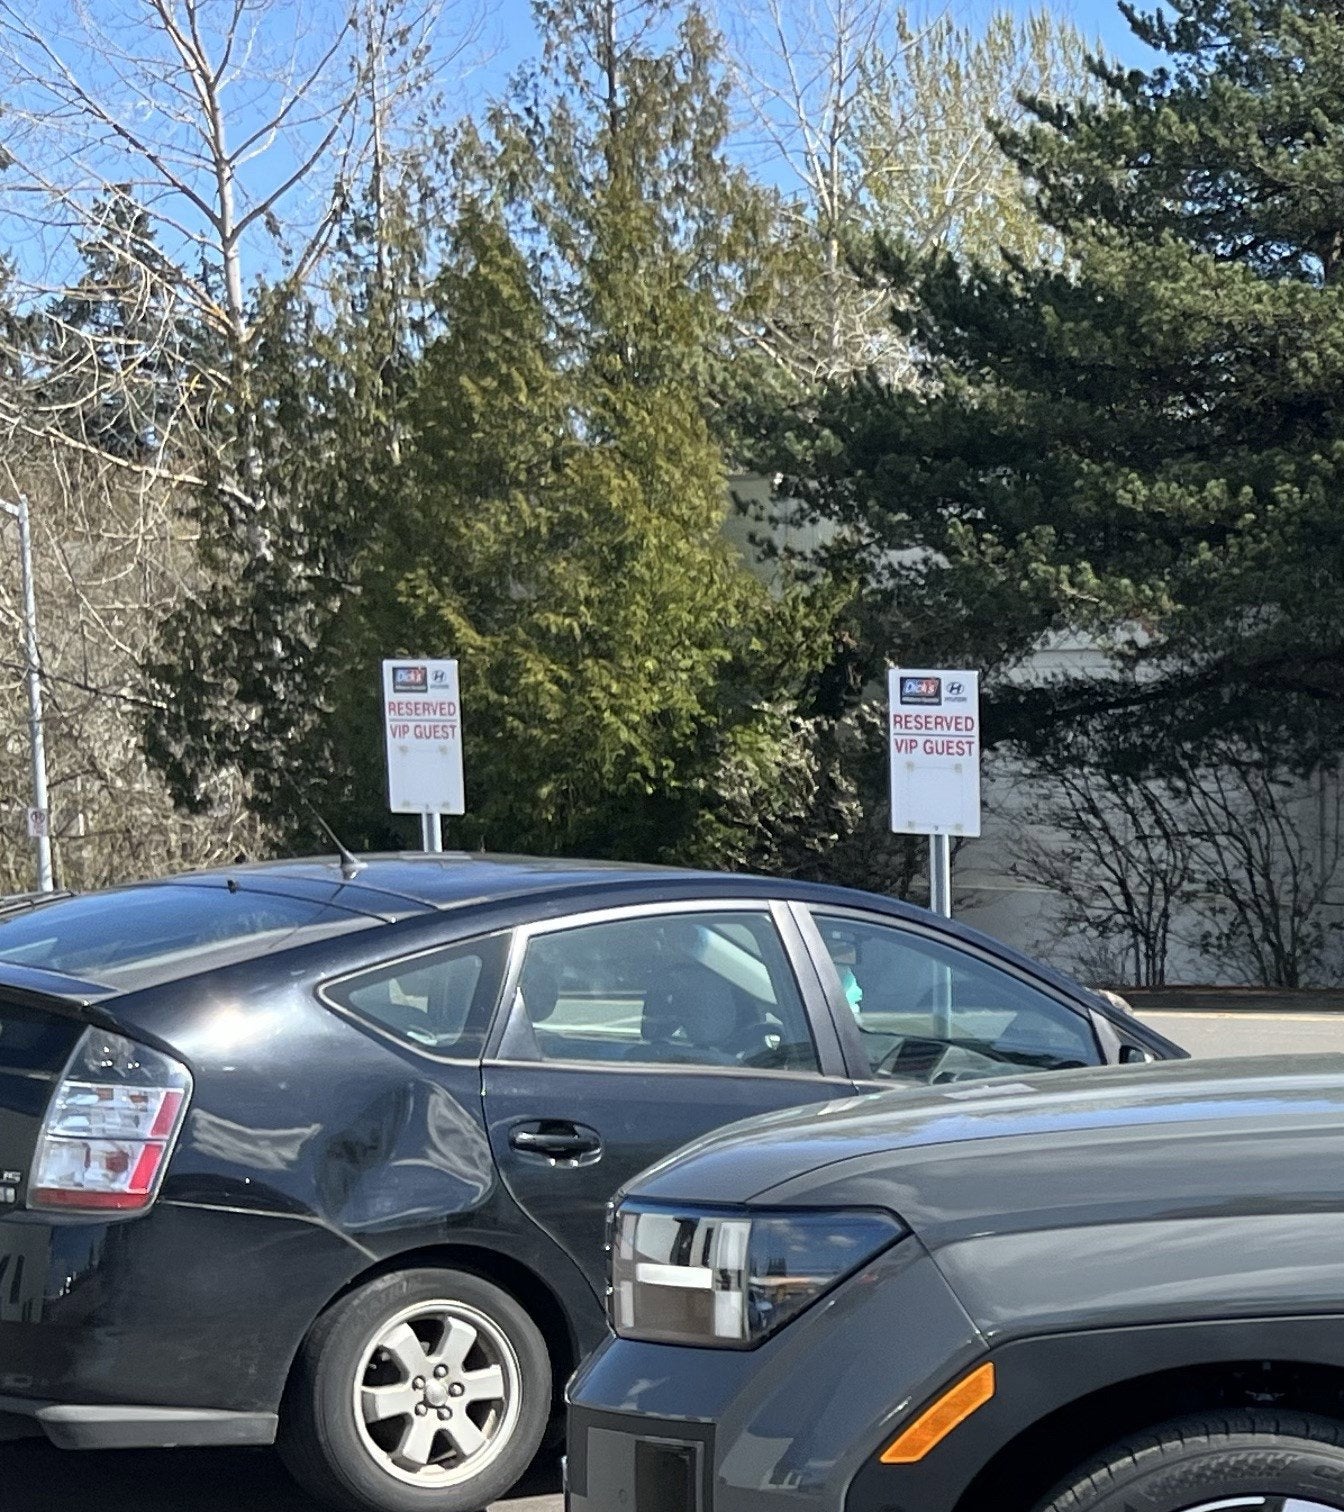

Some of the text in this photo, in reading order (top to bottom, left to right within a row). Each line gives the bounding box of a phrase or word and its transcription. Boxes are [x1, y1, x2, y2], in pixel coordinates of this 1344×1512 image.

[388, 701, 457, 717] RESERVED
[892, 714, 975, 732] RESERVED
[389, 724, 457, 740] VIP GUEST
[894, 738, 975, 757] VIP GUEST
